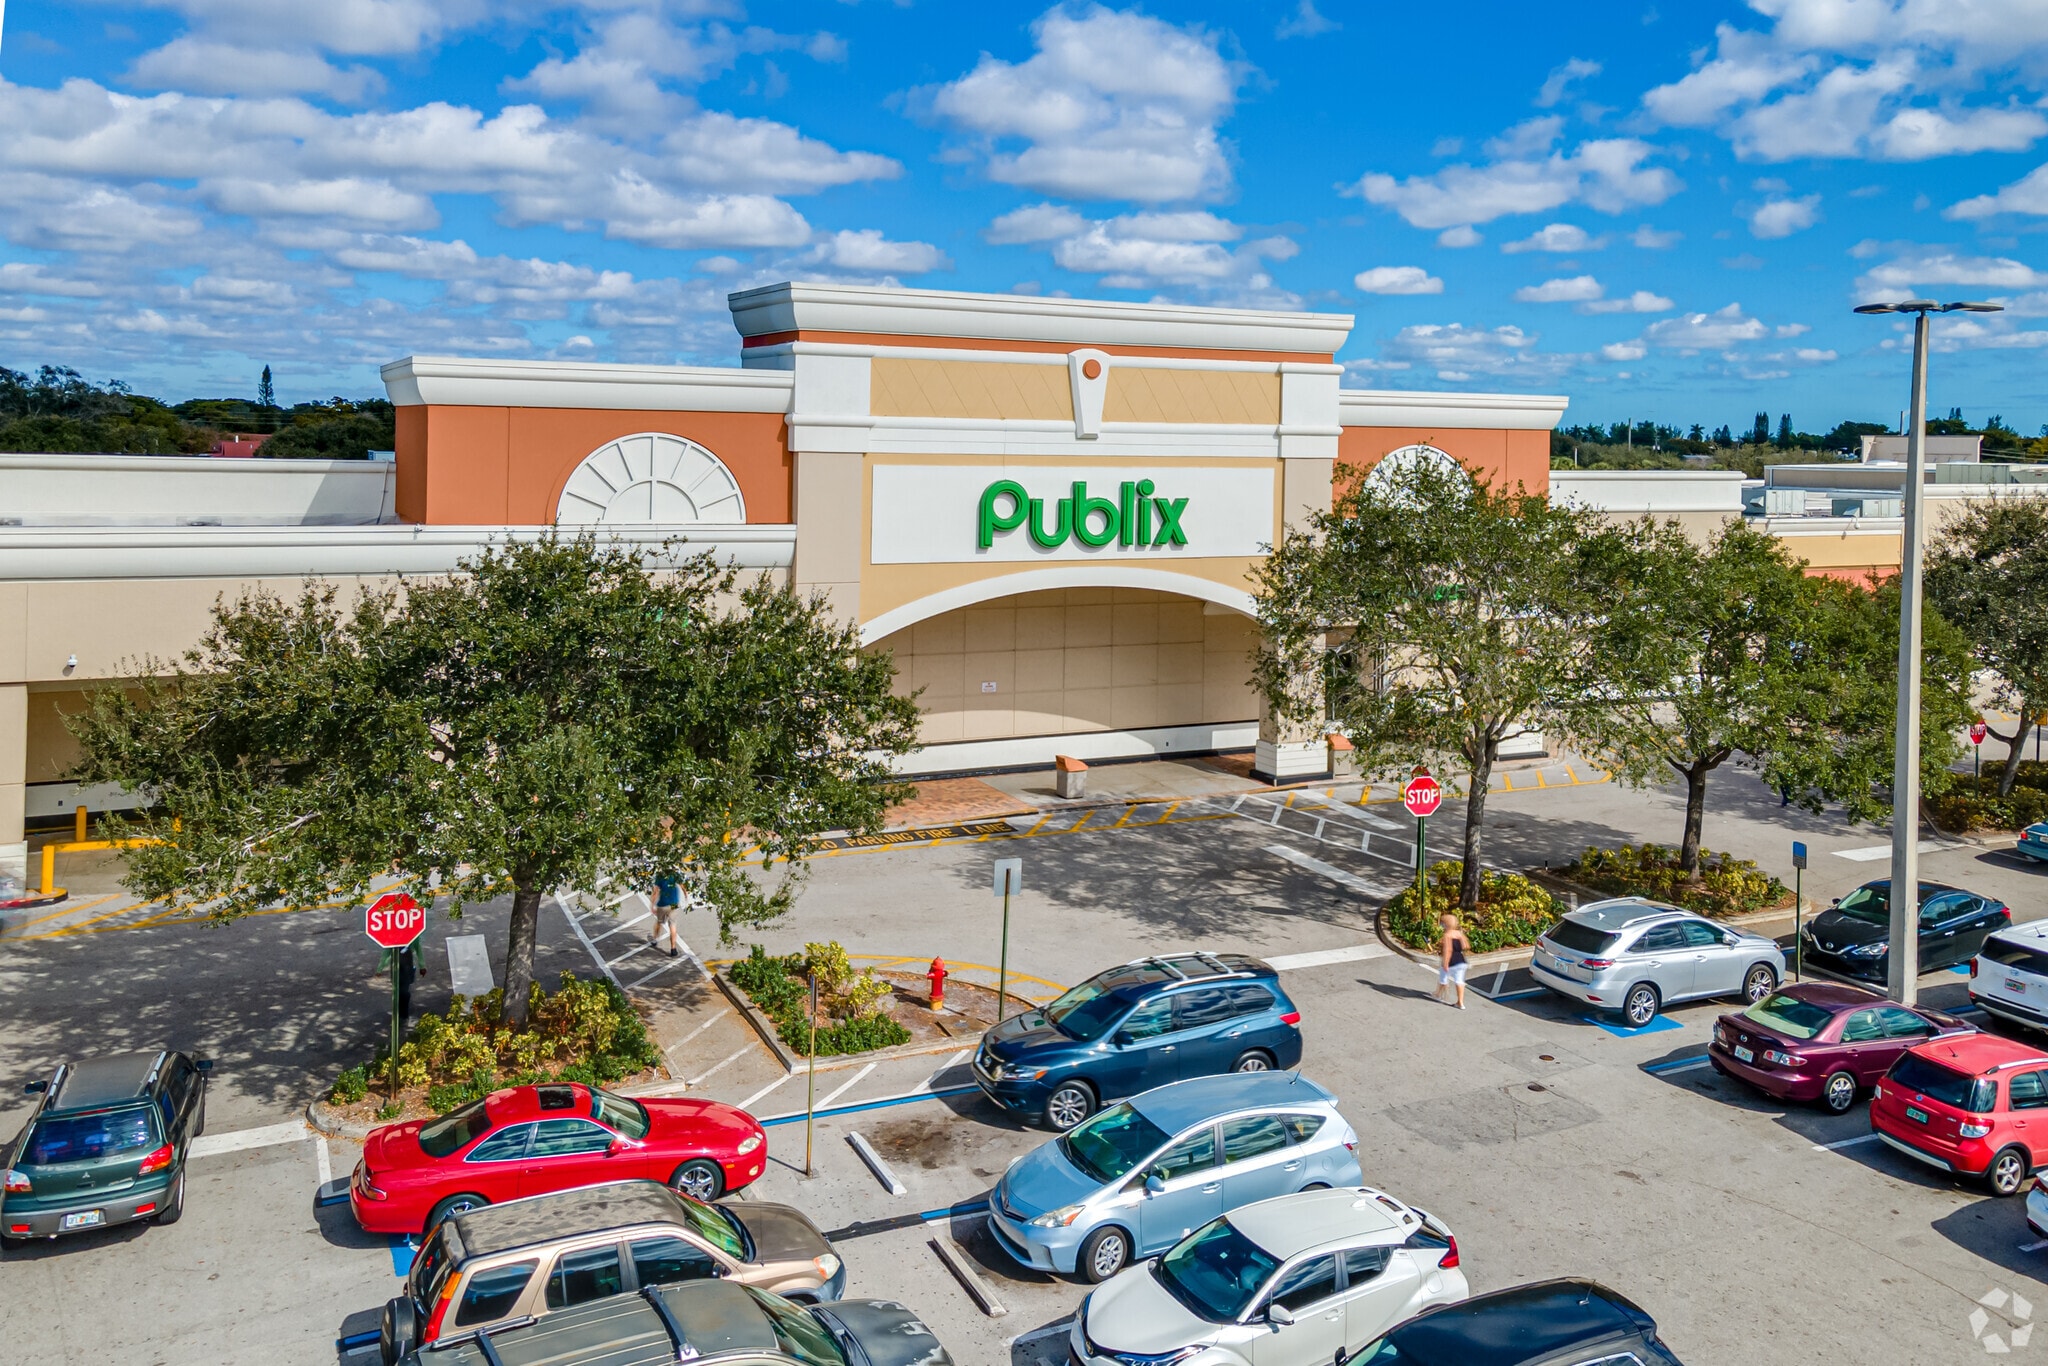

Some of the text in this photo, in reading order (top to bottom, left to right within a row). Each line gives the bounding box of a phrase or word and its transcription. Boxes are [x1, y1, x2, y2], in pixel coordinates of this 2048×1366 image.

[979, 478, 1189, 549] Publix
[1407, 788, 1439, 805] STOP
[843, 831, 915, 848] PARKING
[914, 828, 959, 840] FIRE
[961, 822, 1012, 835] LANE
[370, 908, 422, 932] STOP
